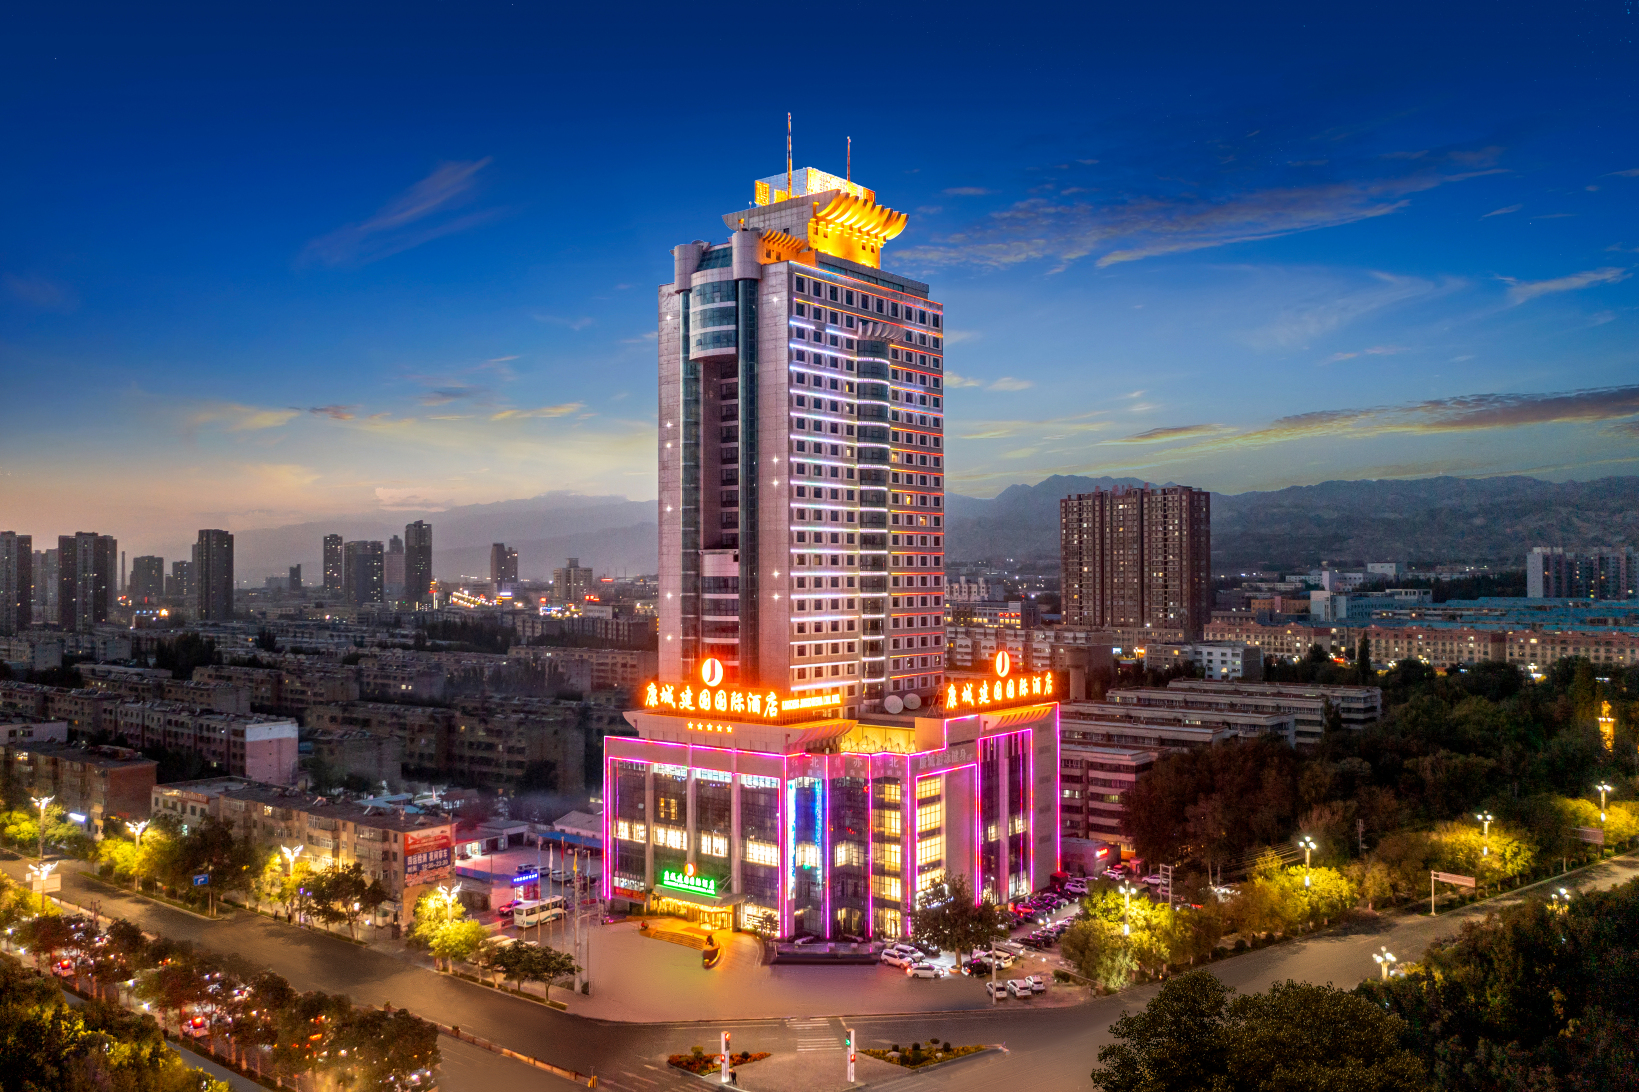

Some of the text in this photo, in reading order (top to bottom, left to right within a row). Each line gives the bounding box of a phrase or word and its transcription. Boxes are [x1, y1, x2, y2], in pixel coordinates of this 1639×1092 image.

[645, 682, 778, 717] 康城建国国际酒店
[946, 672, 1053, 709] 康城建国国际酒店
